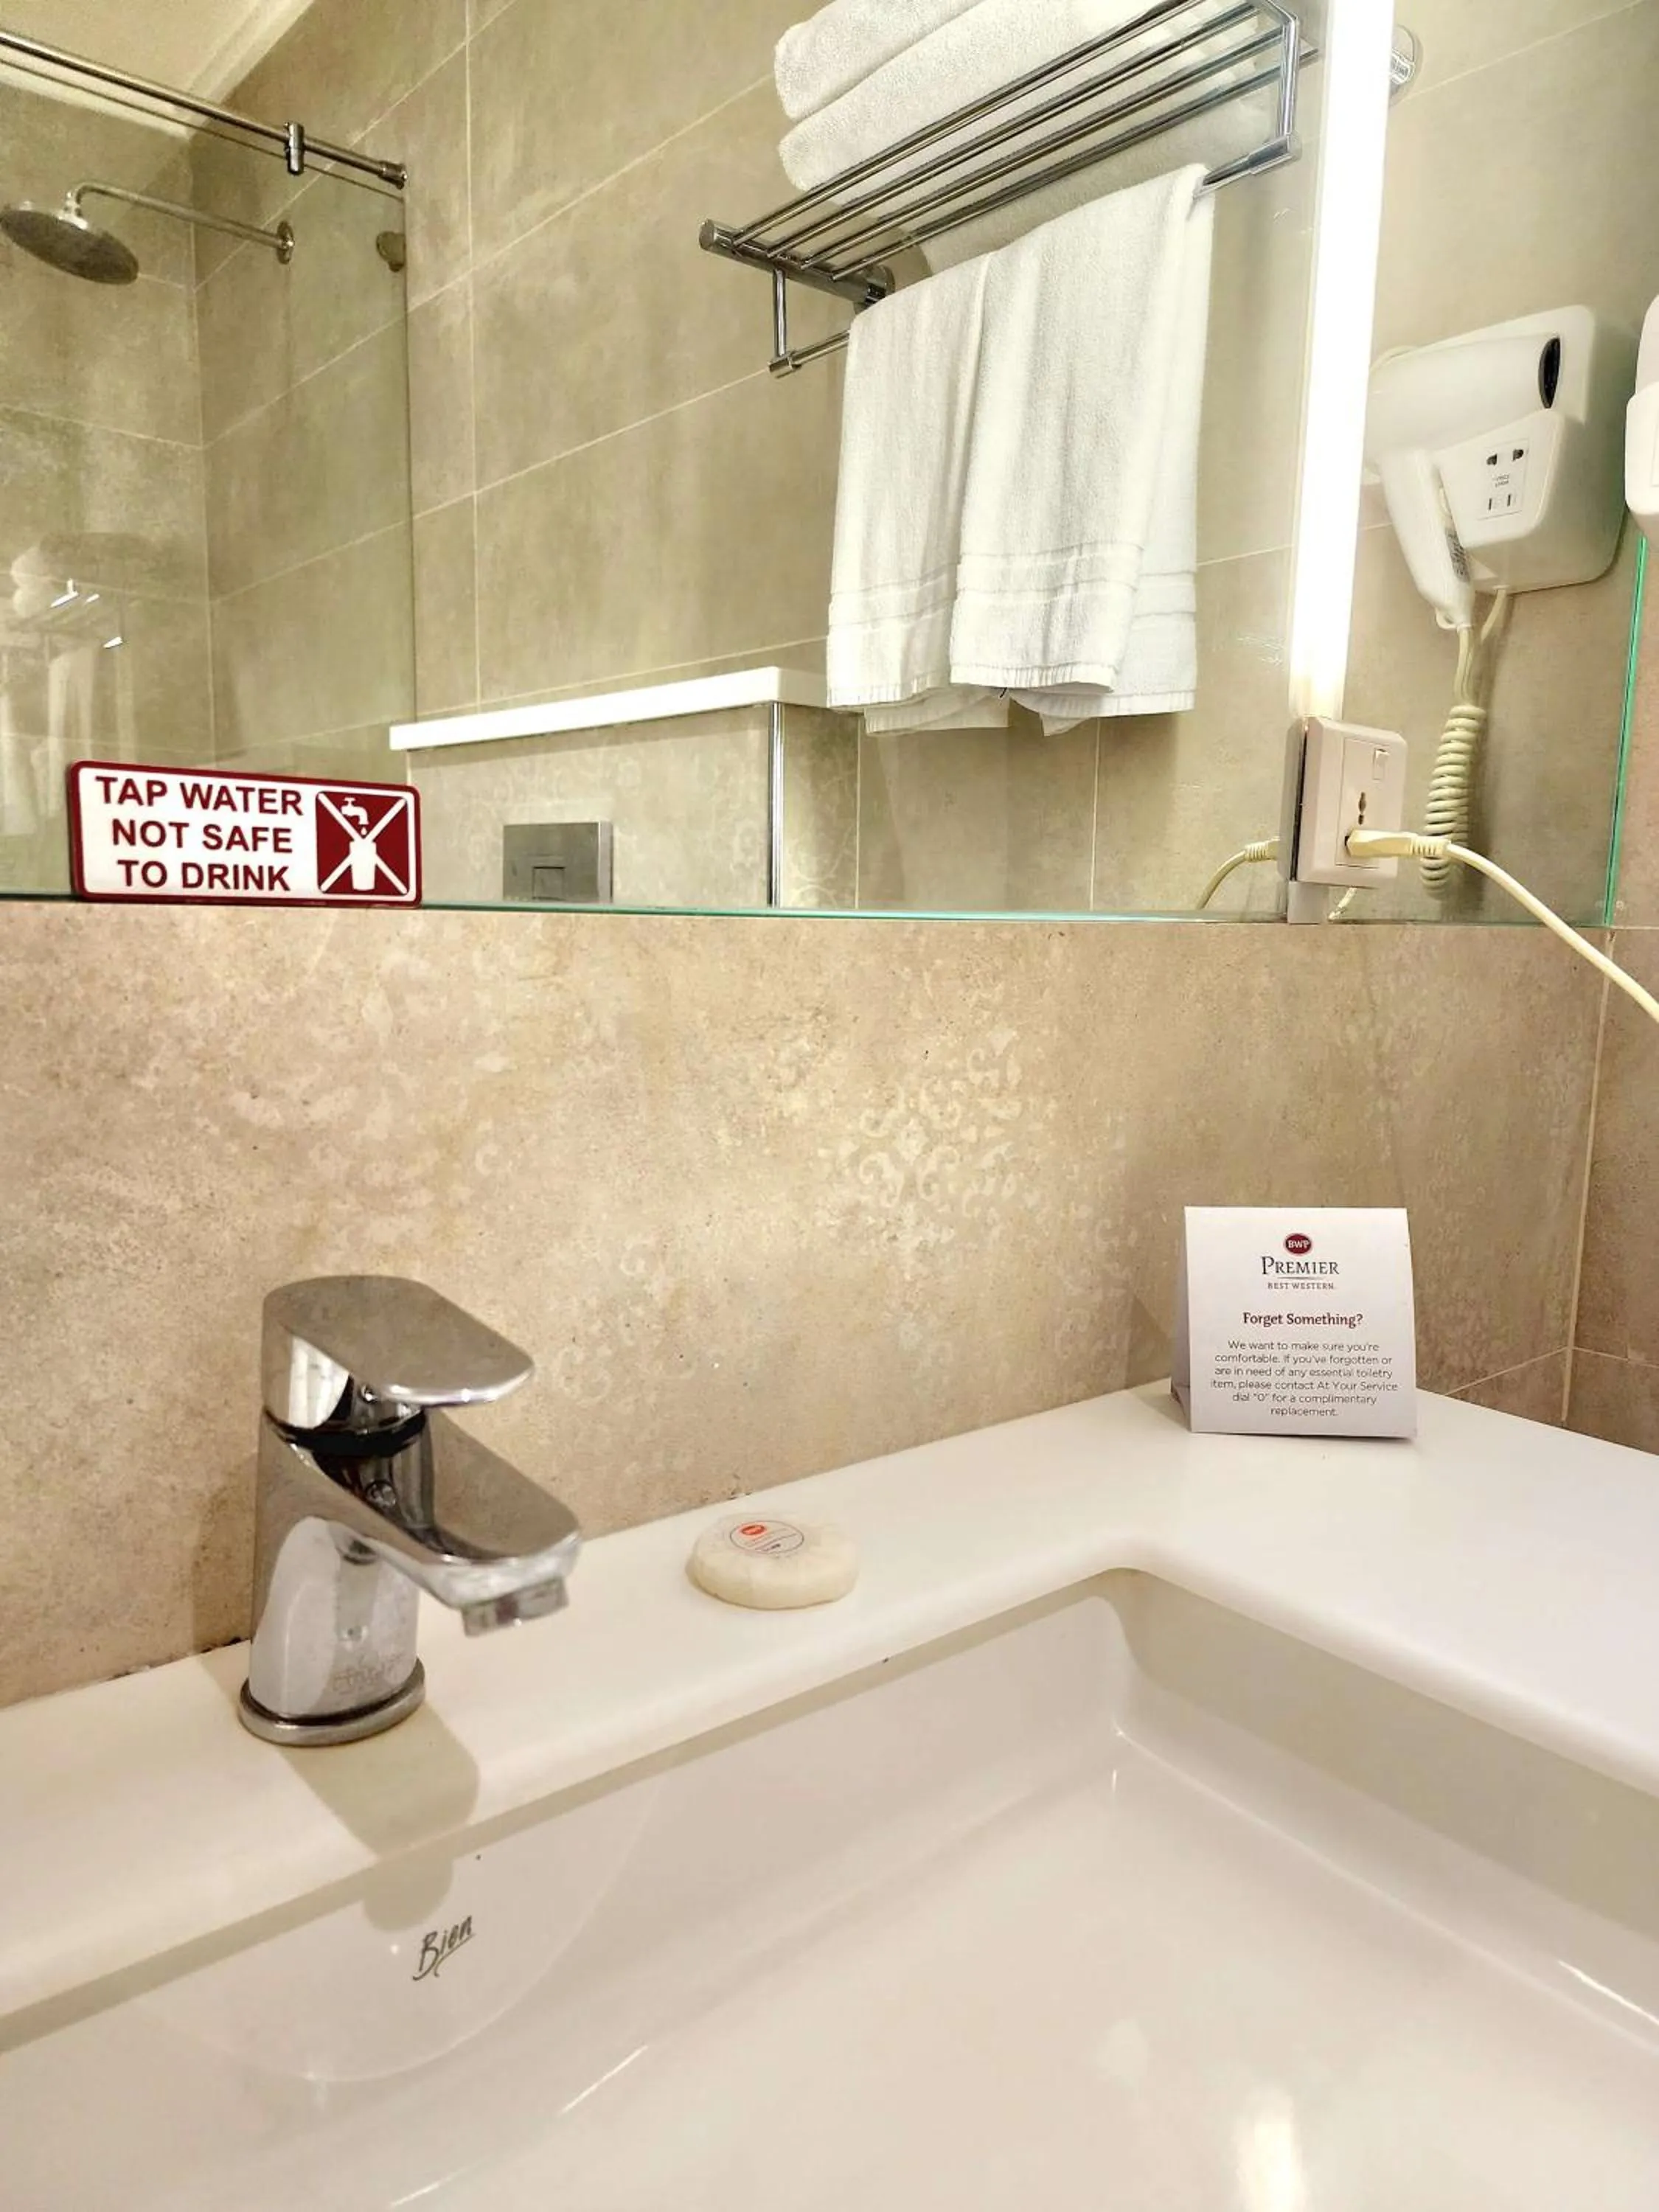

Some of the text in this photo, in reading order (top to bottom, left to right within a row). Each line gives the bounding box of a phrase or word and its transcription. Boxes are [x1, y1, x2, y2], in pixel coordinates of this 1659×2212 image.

[95, 776, 304, 815] TAP WATER
[112, 819, 293, 853] NOT SAFE
[117, 860, 291, 891] TO DRINK
[1287, 1239, 1310, 1249] BWP
[1267, 1282, 1289, 1290] BEST
[1243, 1312, 1363, 1329] Forget Something?
[1228, 1340, 1246, 1350] We
[1248, 1342, 1274, 1350] want
[1277, 1342, 1288, 1350] to
[1291, 1341, 1319, 1351] make
[1322, 1343, 1344, 1352] sure
[1214, 1354, 1281, 1363] comfortable.
[1329, 1355, 1379, 1366] forgotten
[1234, 1366, 1243, 1375] in
[1245, 1367, 1272, 1377] need
[1274, 1366, 1286, 1377] of
[1288, 1369, 1308, 1378] any
[1309, 1368, 1354, 1378] essential
[1356, 1368, 1393, 1380] toiletry
[1238, 1380, 1272, 1391] please
[1274, 1381, 1315, 1391] contact
[1317, 1381, 1330, 1391] At
[1332, 1381, 1358, 1391] Your
[1360, 1381, 1399, 1391] Service
[1232, 1392, 1250, 1402] dial
[1272, 1393, 1287, 1402] for
[1290, 1394, 1296, 1402] a
[1298, 1394, 1377, 1406] complimentary
[1270, 1406, 1339, 1417] replacement.
